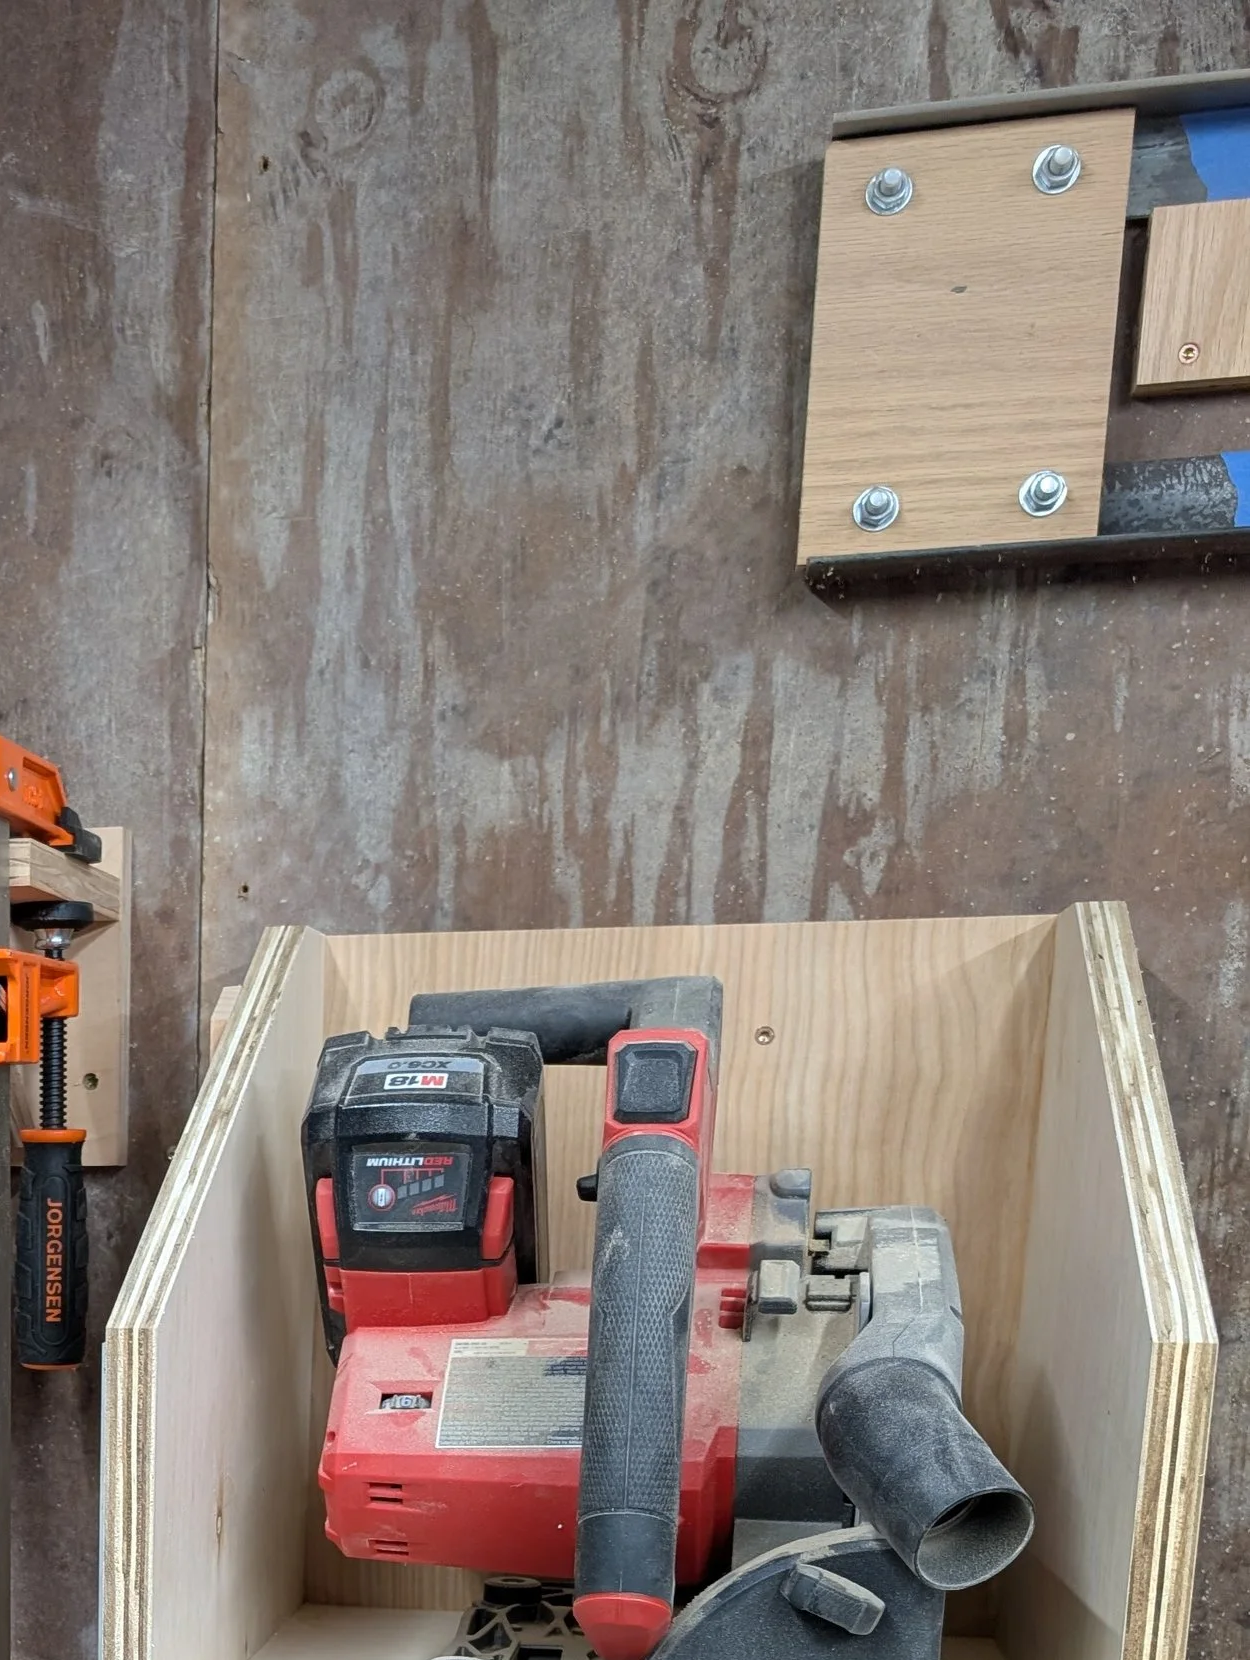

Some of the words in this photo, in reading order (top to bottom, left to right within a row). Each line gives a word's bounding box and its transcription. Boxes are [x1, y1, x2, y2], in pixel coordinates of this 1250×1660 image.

[388, 1075, 445, 1087] M18
[365, 1156, 454, 1167] REDLITHIUM
[45, 1197, 63, 1323] JORGENSEN
